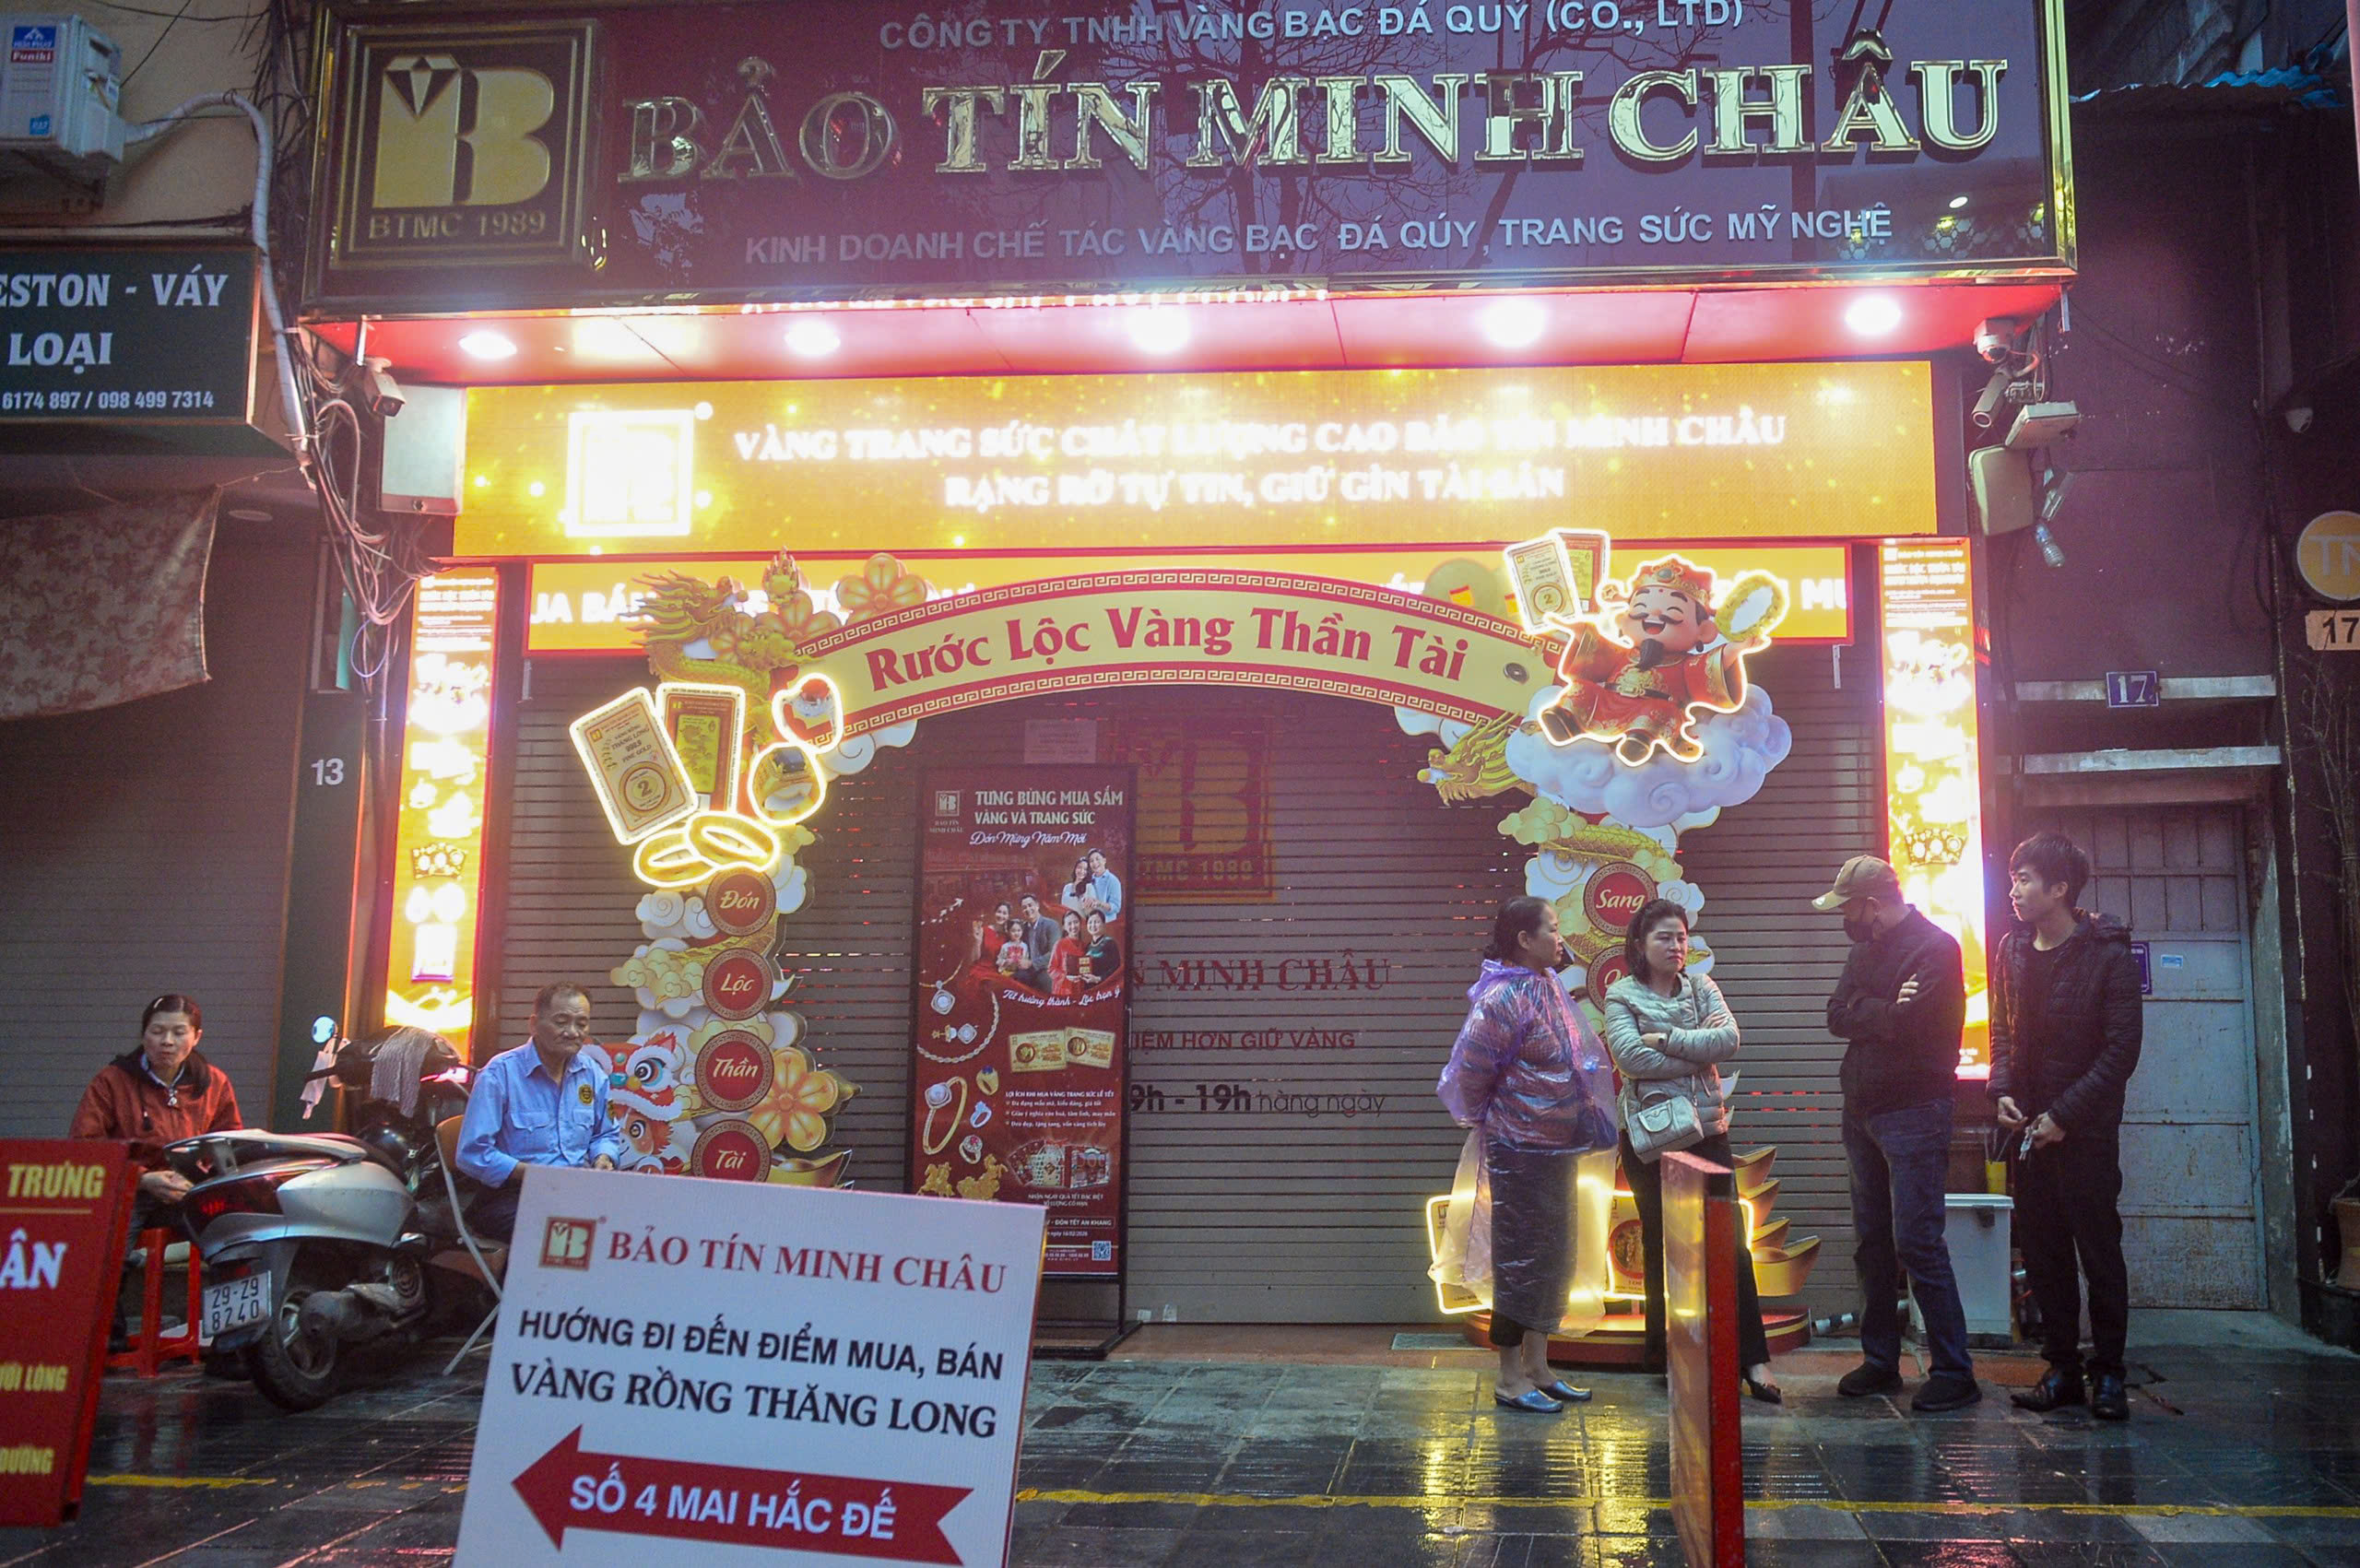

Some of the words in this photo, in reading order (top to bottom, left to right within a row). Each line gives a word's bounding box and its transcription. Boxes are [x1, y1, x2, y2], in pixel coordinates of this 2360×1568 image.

[879, 14, 992, 50] CÔNG
[999, 18, 1051, 46] TY
[1061, 11, 1162, 44] TNHH
[1172, 4, 1274, 43] VÀNG
[1284, 6, 1363, 42] BẠC
[1377, 0, 1435, 34] ĐÁ
[1445, 0, 1531, 34] QUÝ
[1658, 0, 1744, 29] LTD)
[618, 56, 903, 181] BẢO
[924, 50, 1161, 175] TÍN
[1186, 71, 1584, 170] MINH
[1608, 28, 2008, 162] CHÂU
[369, 213, 461, 239] BTMC
[478, 211, 546, 236] 1989
[746, 236, 826, 264] KINH
[839, 232, 964, 263] DOANH
[973, 221, 1044, 258] CHẾ
[1059, 219, 1127, 257] TÁC
[1139, 218, 1233, 255] VÀNG
[1245, 221, 1319, 258] BẠC
[1337, 210, 1388, 251] ĐÁ
[1498, 217, 1623, 247] TRANG
[1638, 206, 1713, 244] SỨC
[1726, 205, 1782, 242] MỸ
[1790, 201, 1893, 241] NGHỆ
[152, 264, 229, 307] VÁY
[8, 333, 113, 374] LOẠI
[2, 391, 44, 410] 6174
[49, 391, 79, 409] 897
[84, 391, 93, 409] /
[98, 391, 131, 408] 098
[135, 390, 168, 408] 499
[171, 390, 215, 408] 7314
[734, 424, 838, 461] VÀNG
[844, 429, 972, 460] TRANG
[1316, 422, 1398, 453] CAO
[1677, 406, 1787, 444] CHÂU
[945, 475, 1050, 514] RẠNG
[1543, 593, 1554, 606] 2
[865, 632, 992, 691] Rước
[1006, 618, 1091, 667] Lộc
[1104, 606, 1234, 650] Vàng
[1249, 605, 1372, 661] Thần
[1390, 624, 1470, 681] Tài
[2117, 674, 2149, 704] 17
[312, 758, 345, 786] 13
[637, 780, 653, 798] 2
[1060, 790, 1090, 806] MUA
[974, 808, 1008, 825] VÀNG
[1011, 808, 1027, 824] VÀ
[1029, 811, 1069, 824] TRANG
[720, 891, 760, 911] Đón
[1596, 889, 1646, 914] Sang
[720, 973, 755, 996] Lộc
[1155, 958, 1265, 993] MINH
[1278, 948, 1390, 992] CHÂU
[1182, 1031, 1233, 1049] HƠN
[1241, 1026, 1283, 1050] GIỮ
[1291, 1026, 1356, 1049] VÀNG
[712, 1056, 759, 1081] Thần
[1196, 1084, 1252, 1112] 19h
[1259, 1089, 1319, 1119] hàng
[1328, 1088, 1386, 1119] ngày
[716, 1149, 747, 1170] Tài
[607, 1225, 690, 1266] BẢO
[700, 1232, 768, 1272] TÍN
[774, 1246, 882, 1285] MINH
[893, 1251, 1009, 1293] CHÂU
[212, 1300, 258, 1331] 8240
[518, 1308, 633, 1348] HƯỚNG
[643, 1322, 677, 1350] ĐI
[684, 1313, 749, 1359] ĐẾN
[757, 1324, 838, 1366] ĐIỂM
[848, 1340, 926, 1379] MUA,
[936, 1341, 1003, 1381] BÁN
[510, 1358, 615, 1402] VÀNG
[623, 1366, 732, 1414] RỒNG
[744, 1385, 878, 1427] THĂNG
[888, 1401, 997, 1439] LONG
[569, 1462, 627, 1514] SỐ
[634, 1487, 656, 1517] 4
[667, 1487, 738, 1525] MAI
[748, 1488, 832, 1533] HẮC
[841, 1488, 898, 1539] ĐẾ
